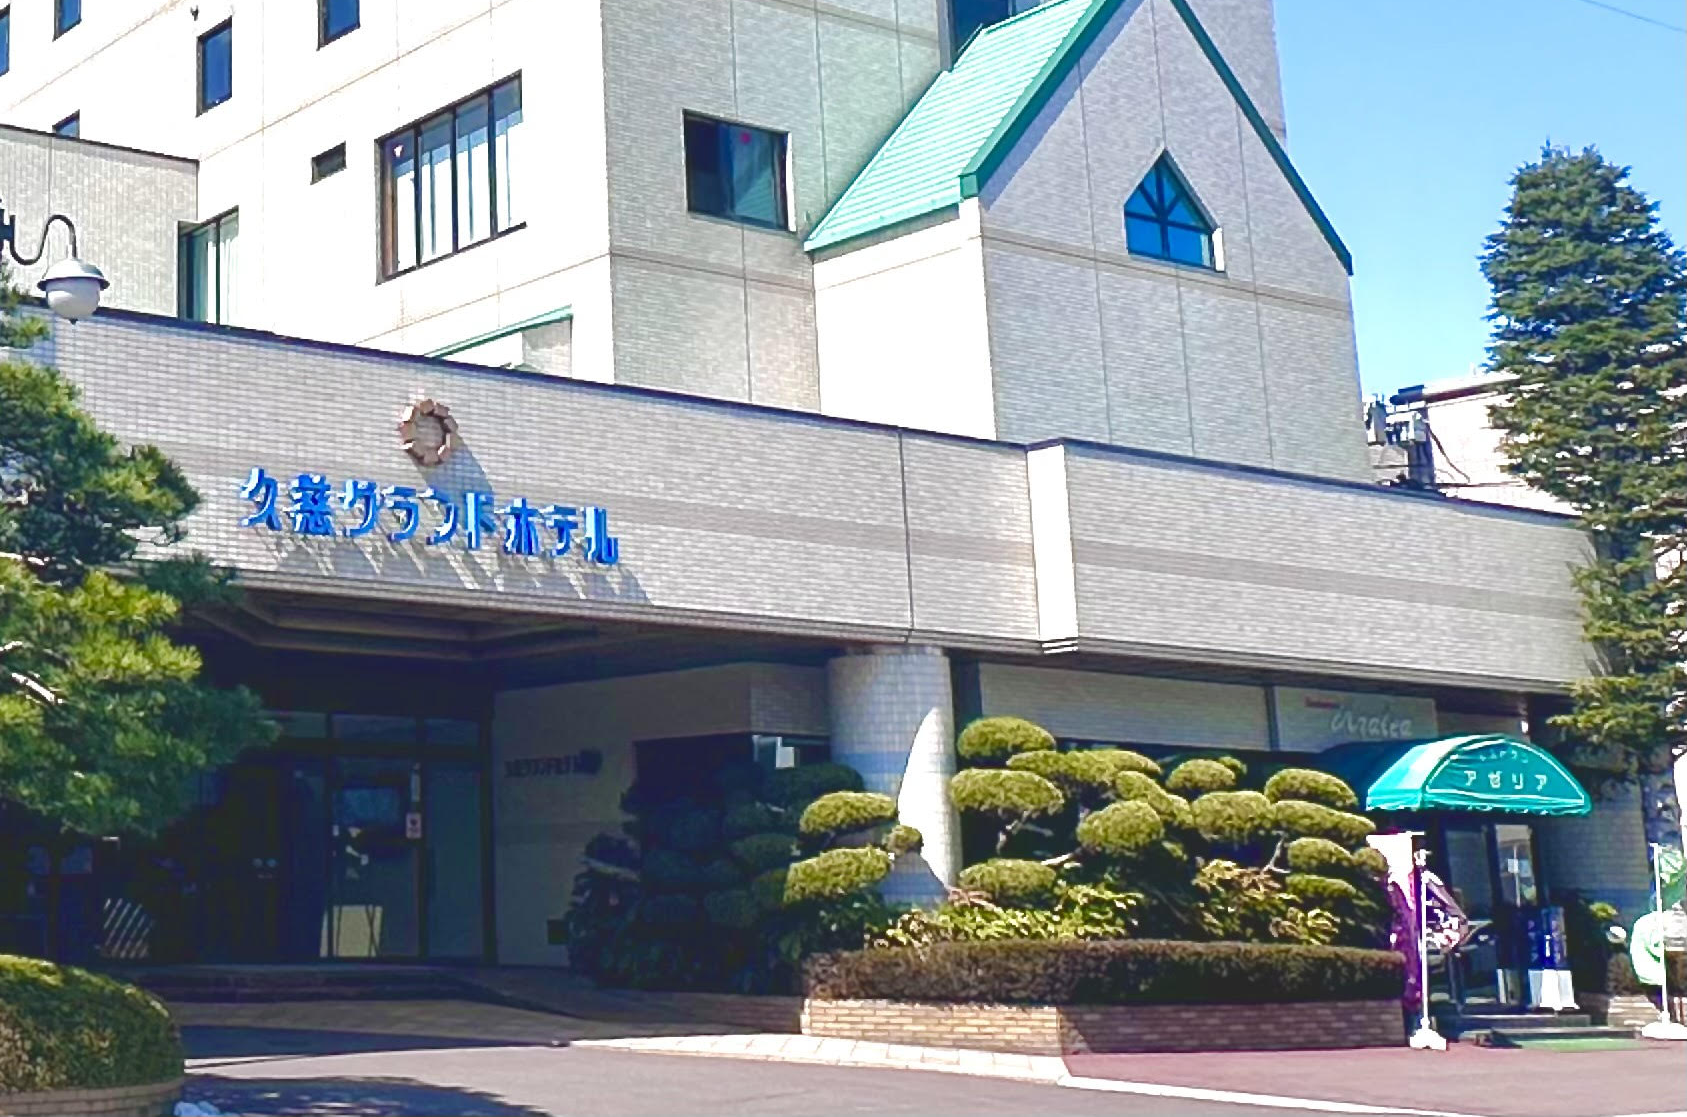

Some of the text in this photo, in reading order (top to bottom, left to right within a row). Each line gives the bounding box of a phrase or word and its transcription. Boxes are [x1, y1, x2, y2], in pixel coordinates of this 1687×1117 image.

[240, 466, 619, 565] 久慈グランドホテル
[1465, 770, 1547, 791] アゼリア
